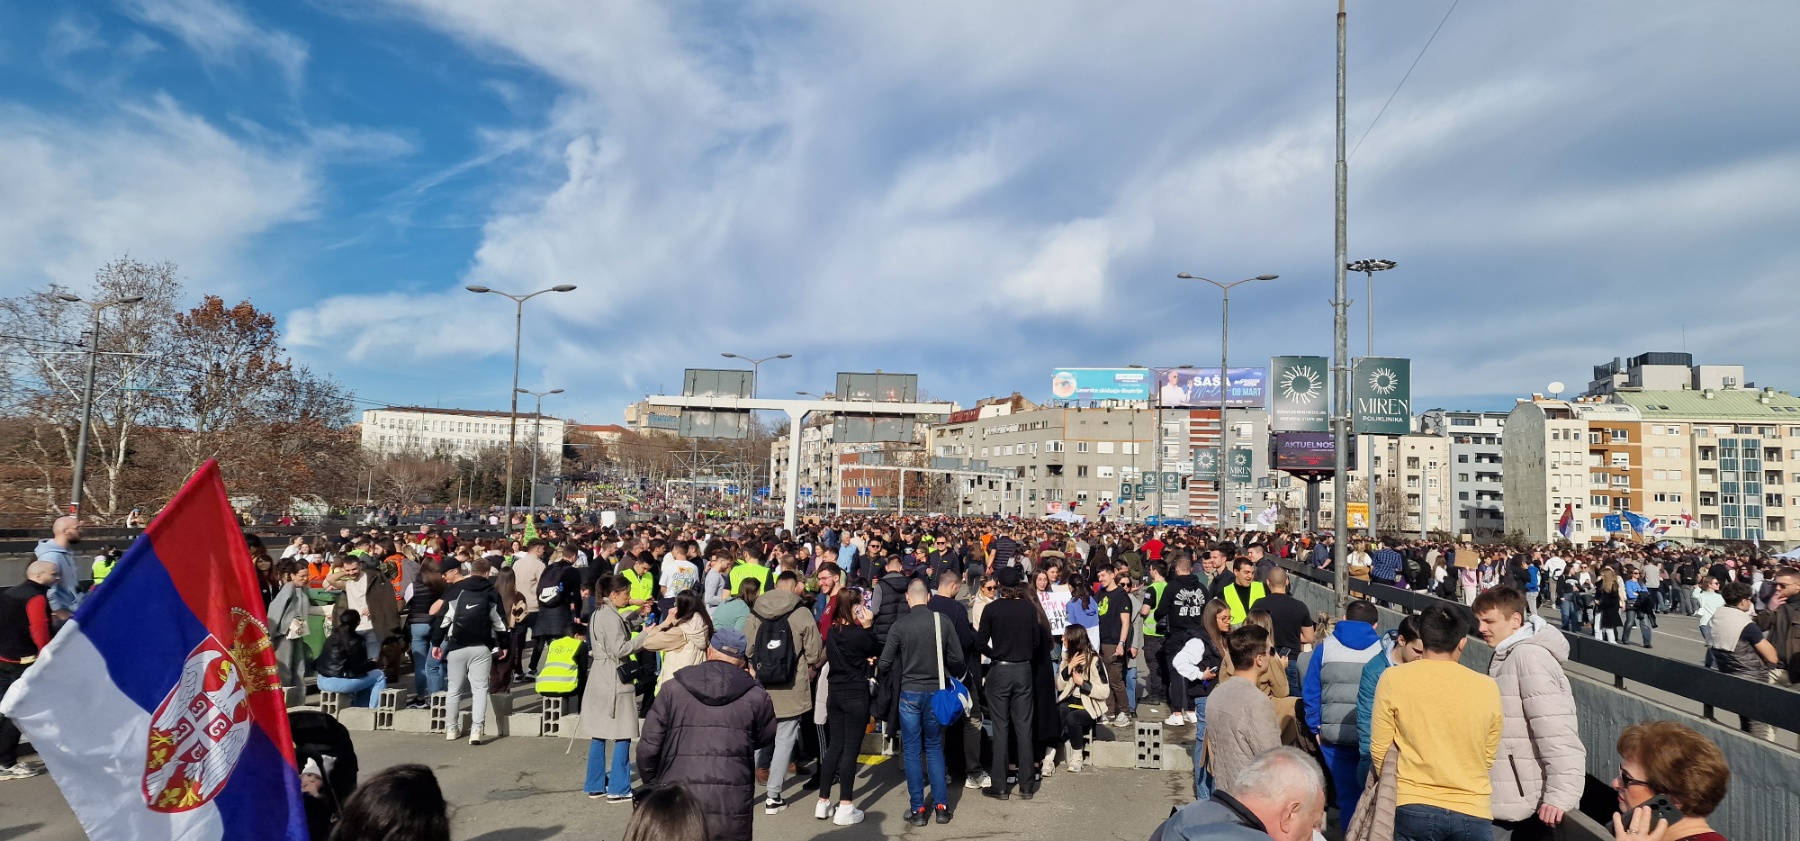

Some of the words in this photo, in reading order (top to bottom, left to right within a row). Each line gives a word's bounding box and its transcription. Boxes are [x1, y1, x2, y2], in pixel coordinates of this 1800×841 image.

[1358, 397, 1408, 415] MIREN
[1362, 415, 1403, 423] POLIKLINIKA
[1284, 441, 1335, 449] AKTUELNOS
[541, 585, 559, 598] NIKE
